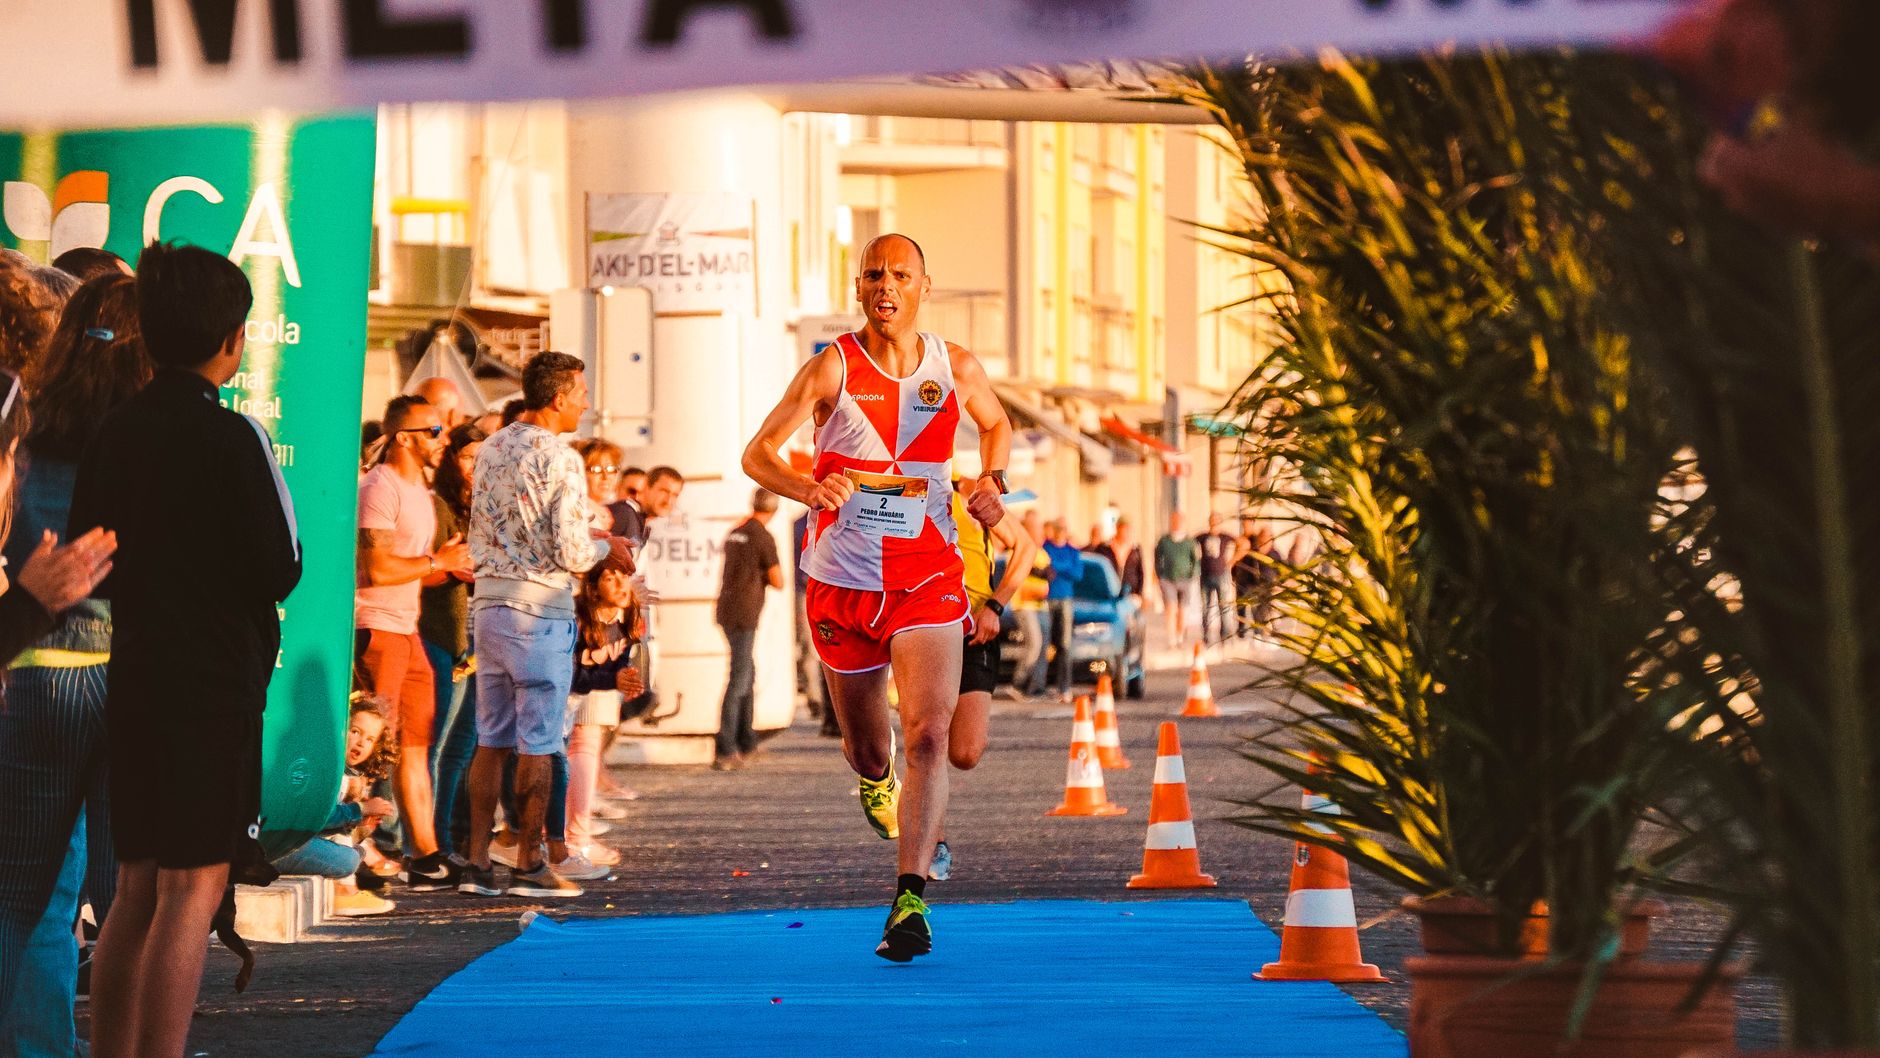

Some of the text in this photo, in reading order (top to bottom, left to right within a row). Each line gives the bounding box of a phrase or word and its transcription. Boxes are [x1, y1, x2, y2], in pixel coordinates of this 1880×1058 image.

[143, 176, 302, 288] CA
[233, 394, 282, 419] local
[880, 497, 888, 509] 2
[861, 508, 904, 518] PEDRO JANUÁRIO
